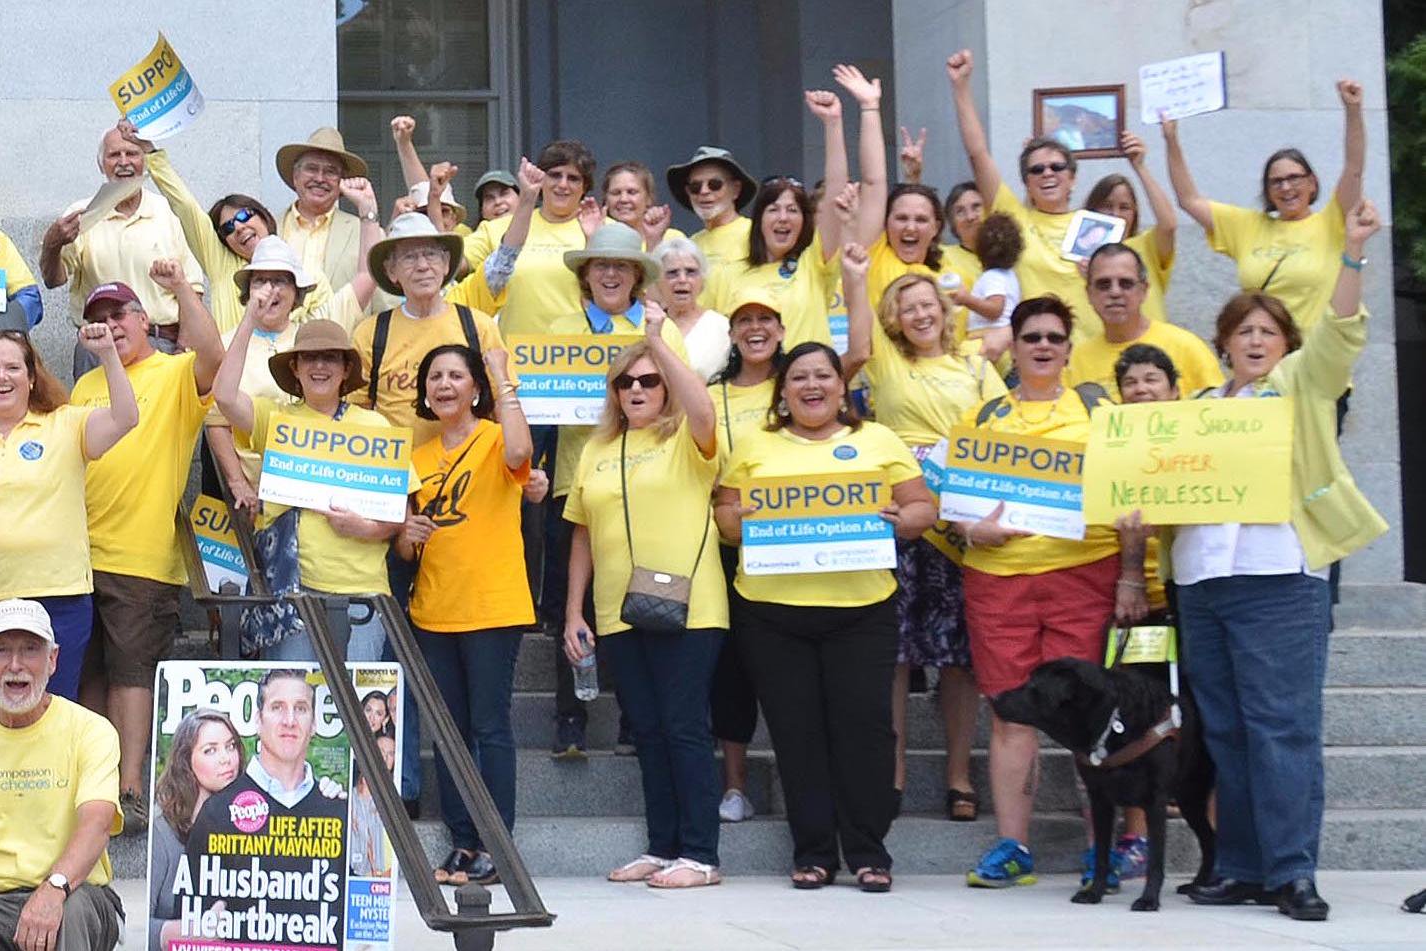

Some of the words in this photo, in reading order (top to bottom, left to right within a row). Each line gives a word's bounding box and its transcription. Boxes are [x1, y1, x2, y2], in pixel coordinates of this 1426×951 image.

[149, 102, 161, 115] of
[160, 89, 178, 108] Life
[515, 345, 622, 366] SUPPOR
[539, 377, 551, 391] of
[553, 378, 574, 391] Life
[577, 379, 607, 393] Optio
[275, 424, 405, 462] SUPPORT
[956, 438, 1084, 476] SUPPORT
[269, 456, 293, 471] End
[294, 458, 309, 474] of
[311, 460, 335, 478] Life
[335, 465, 378, 487] Option
[379, 471, 403, 487] Act
[749, 481, 882, 510] SUPPORT
[949, 474, 972, 488] End
[973, 476, 988, 490] of
[990, 478, 1014, 494] Life
[1015, 483, 1059, 500] Option
[749, 523, 773, 538] End
[774, 523, 788, 537] of
[789, 521, 815, 537] Life
[817, 521, 860, 538] Option
[861, 519, 885, 533] Act
[203, 543, 214, 555] of
[214, 547, 235, 563] Life
[1, 779, 51, 791] choices
[229, 800, 270, 822] People
[269, 816, 296, 836] LIFE
[299, 816, 342, 838] AFTER
[208, 833, 272, 857] BRITTANY
[273, 836, 342, 859] MAYNARD
[172, 854, 194, 896] A
[198, 855, 340, 902] Husband's
[350, 895, 373, 907] TEEN
[180, 895, 338, 945] Heartbreak
